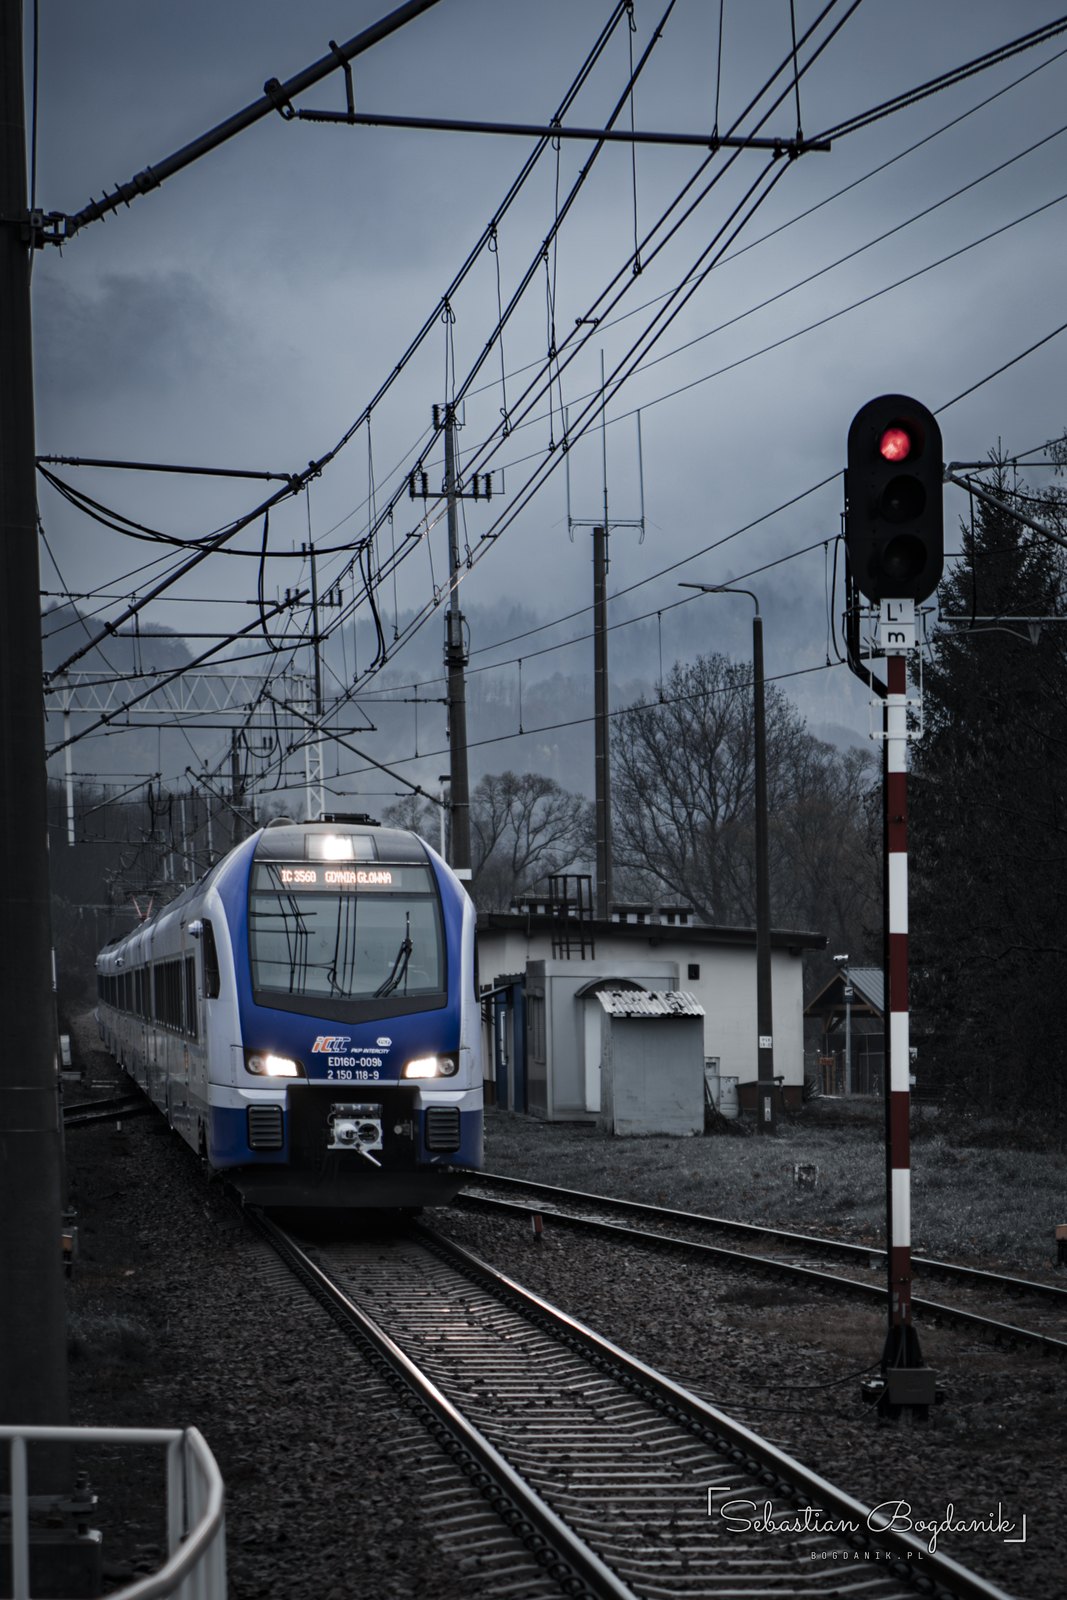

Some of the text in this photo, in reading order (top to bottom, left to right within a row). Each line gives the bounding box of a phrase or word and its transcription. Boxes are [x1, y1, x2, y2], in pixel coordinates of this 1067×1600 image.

[888, 632, 905, 643] m
[281, 870, 293, 882] IC
[293, 871, 317, 883] 3560
[325, 871, 356, 883] GDYNIA
[328, 1057, 383, 1067] ED160-009b
[327, 1070, 379, 1080] 2 150 118-9
